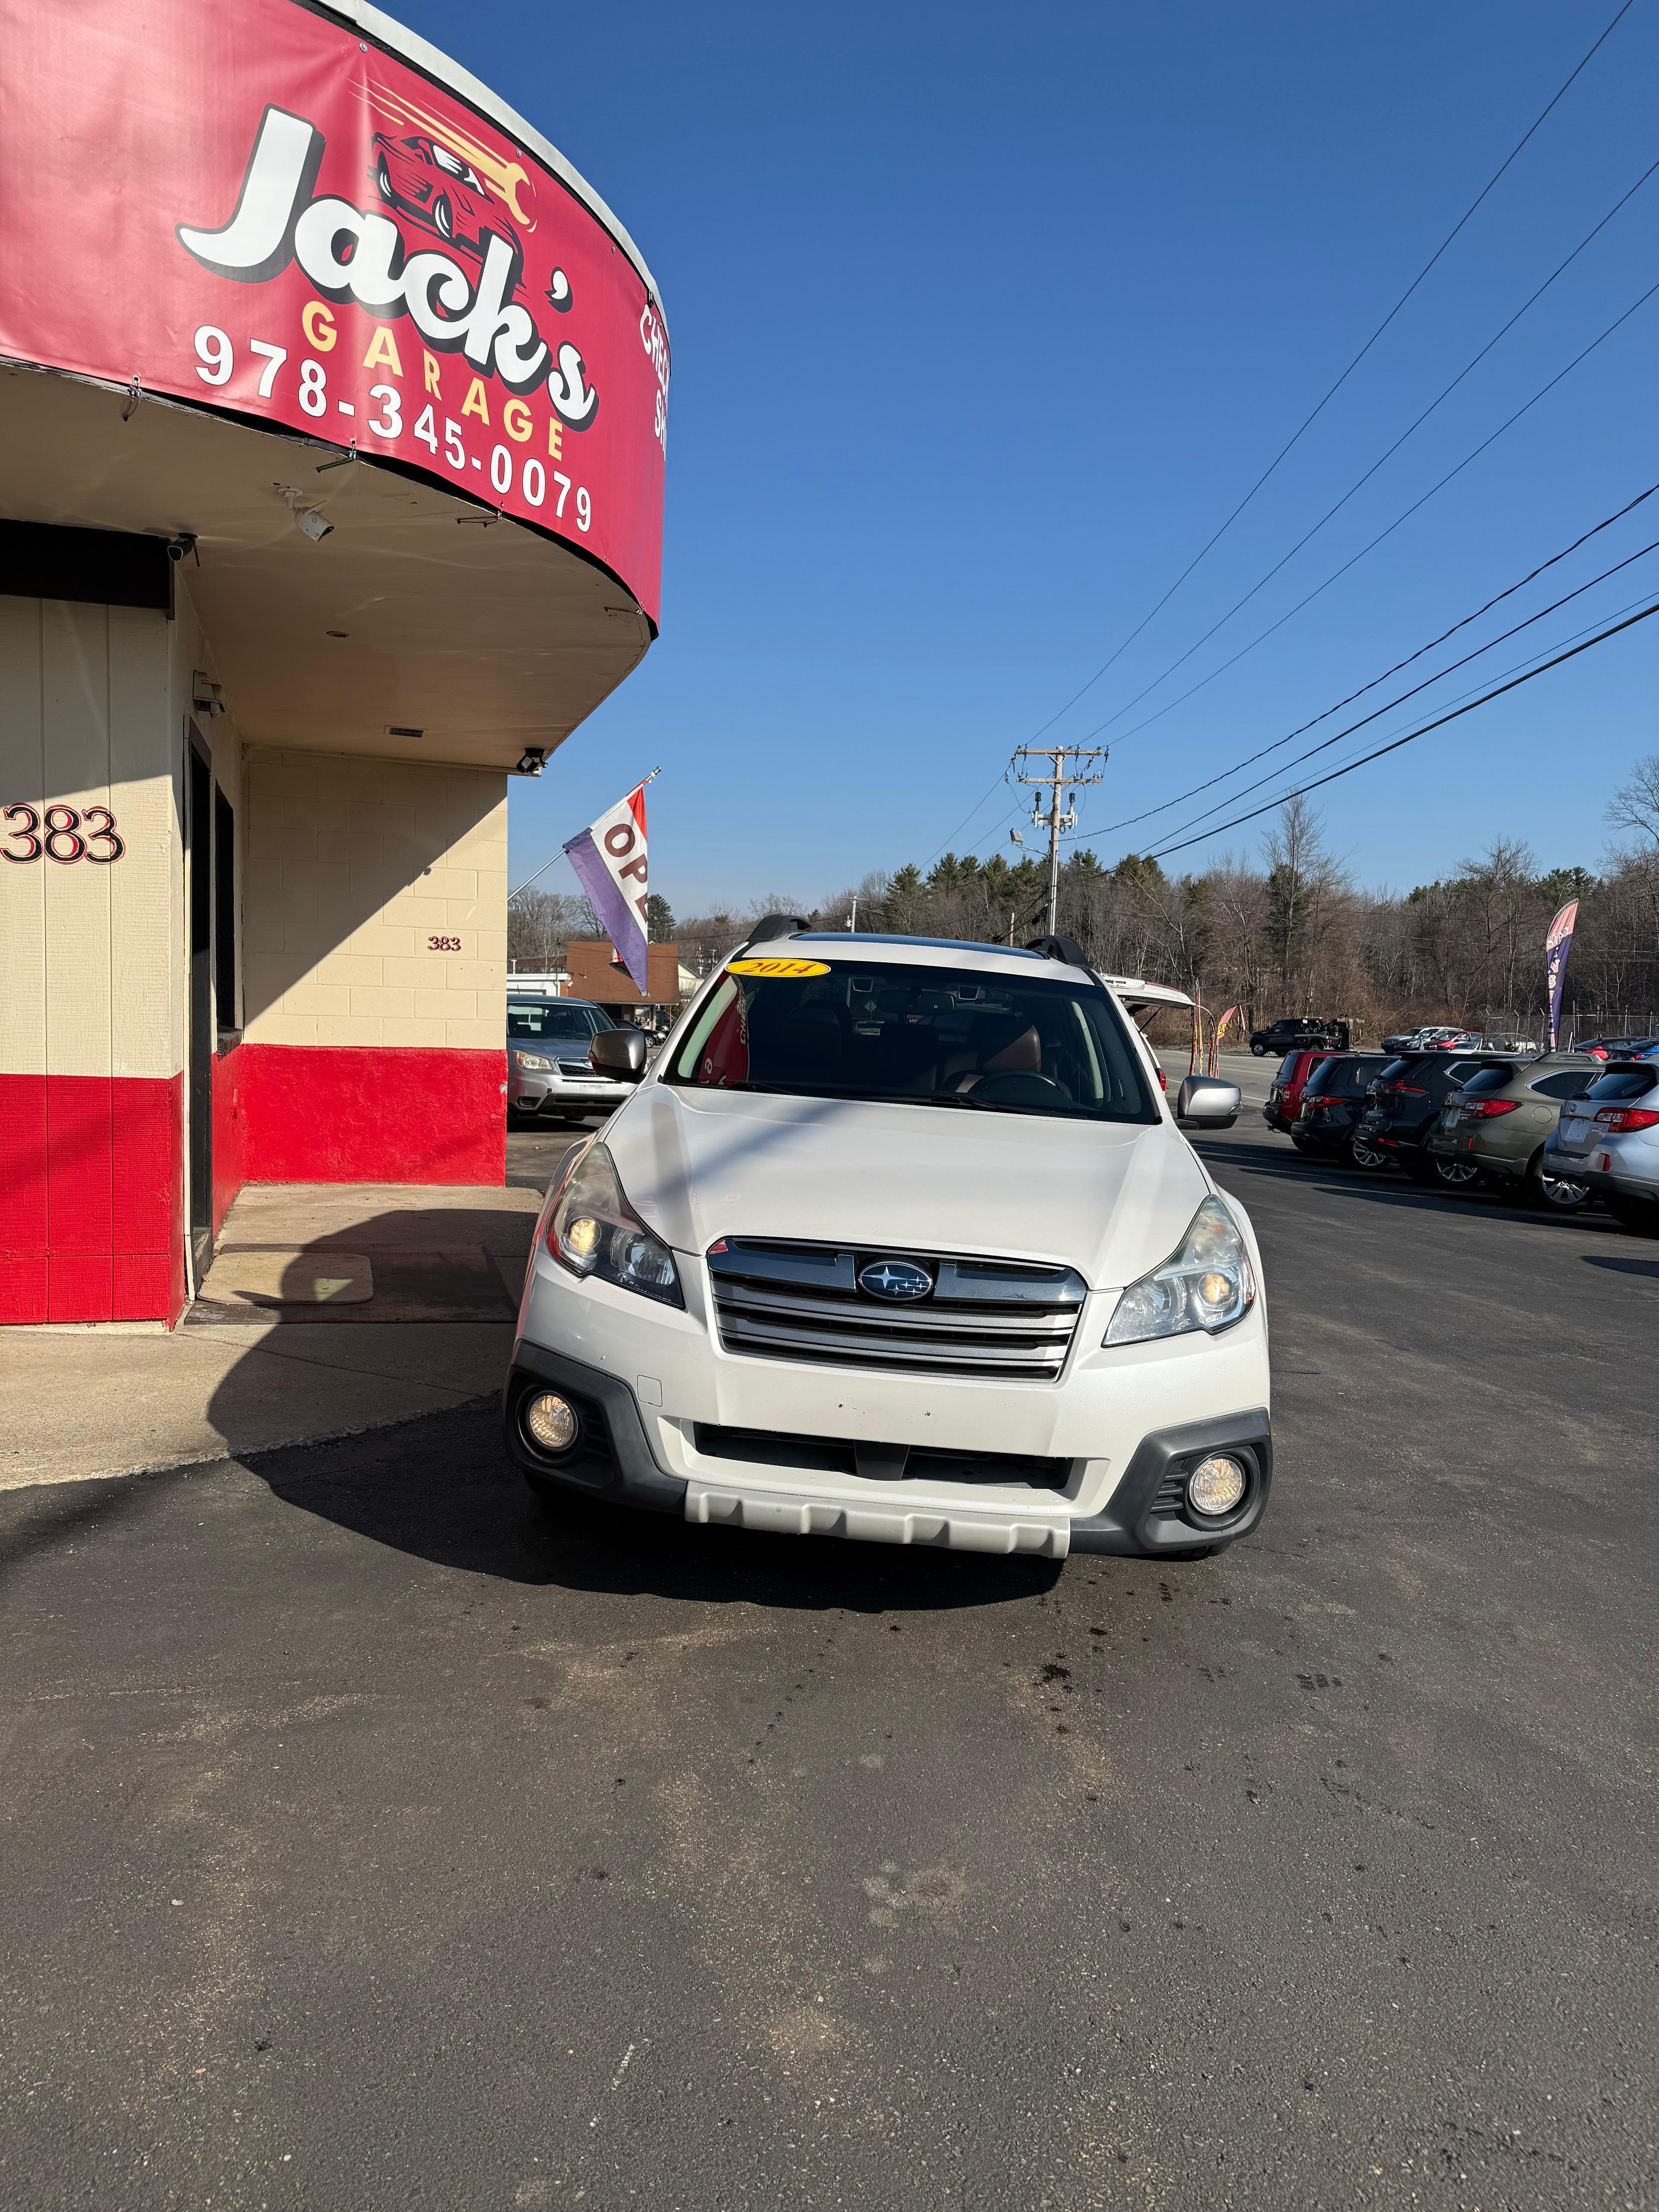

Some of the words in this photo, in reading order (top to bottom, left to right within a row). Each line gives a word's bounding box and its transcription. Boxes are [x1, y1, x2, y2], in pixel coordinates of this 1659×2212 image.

[176, 103, 598, 429] Jack's
[194, 325, 592, 534] 978-345-0079
[302, 300, 563, 461] GARAGE
[0, 802, 125, 864] 383
[427, 936, 461, 951] 383
[741, 962, 816, 974] 2014
